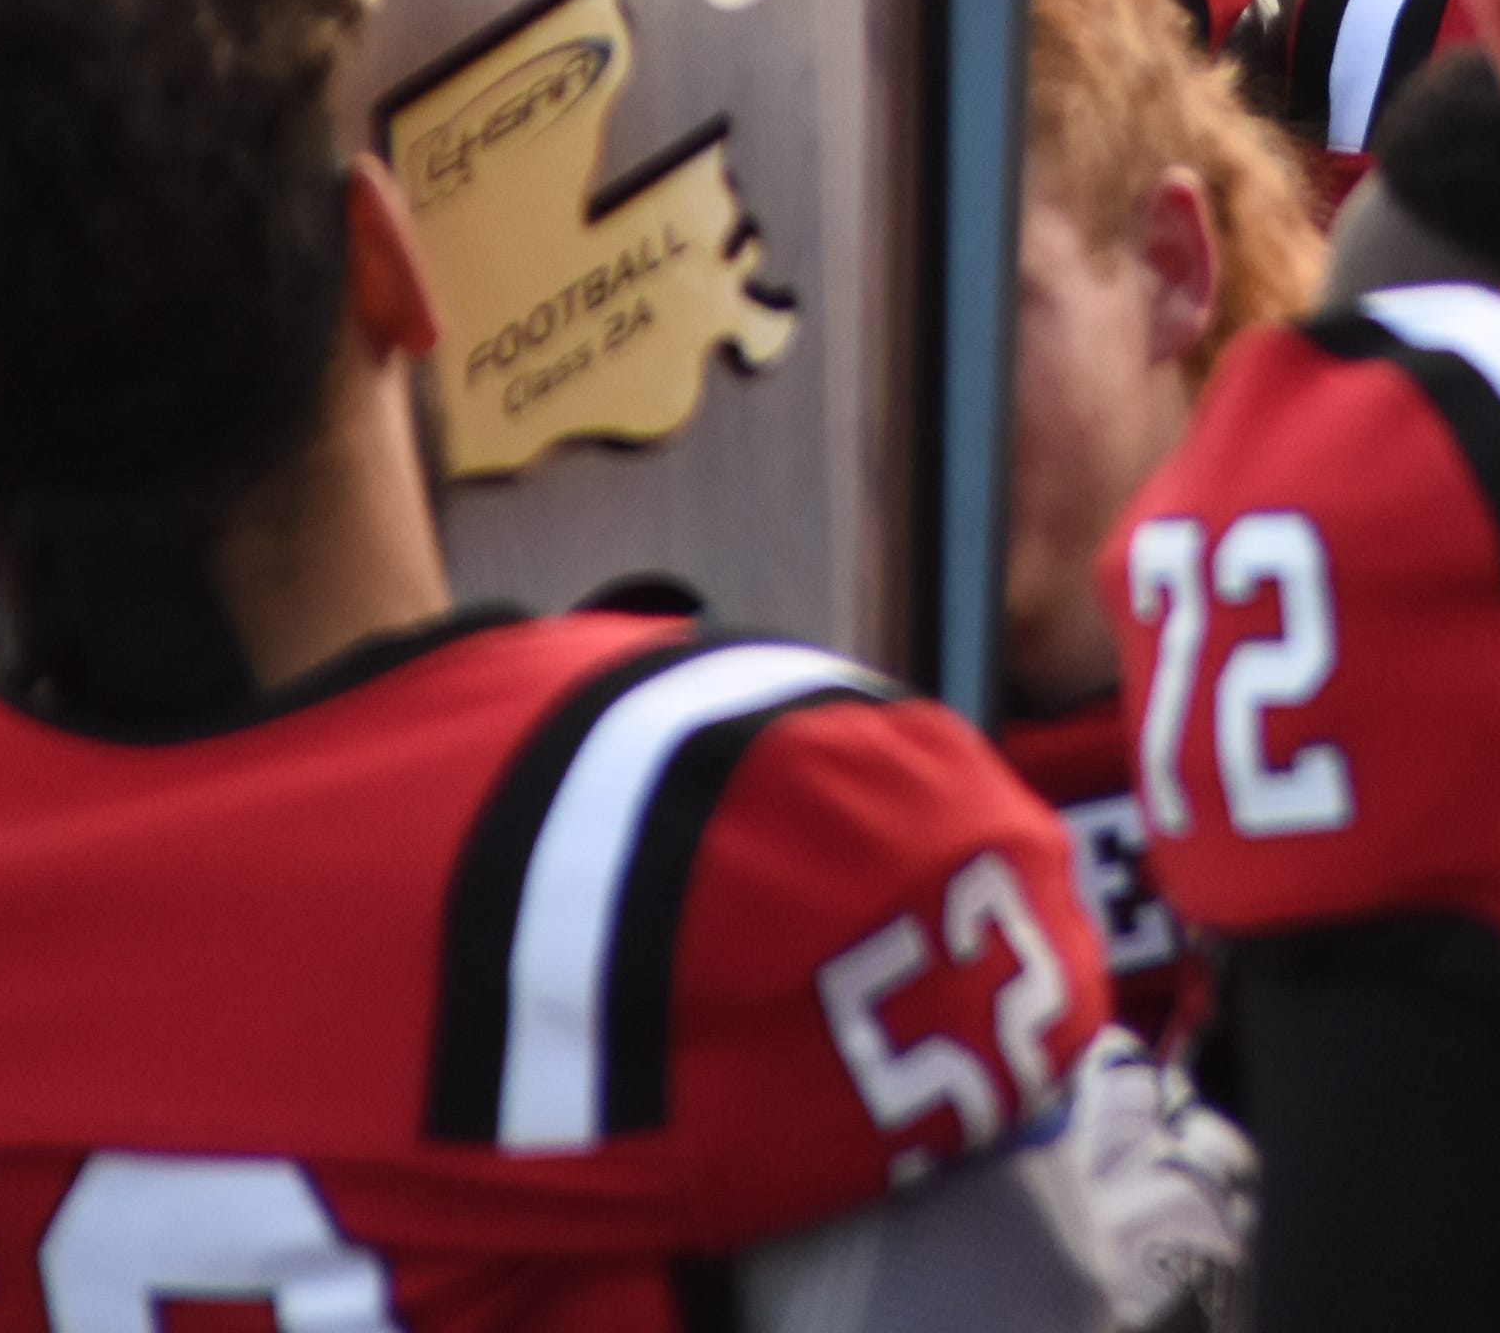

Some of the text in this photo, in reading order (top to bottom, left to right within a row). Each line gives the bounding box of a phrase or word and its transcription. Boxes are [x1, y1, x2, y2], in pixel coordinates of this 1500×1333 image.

[465, 221, 690, 393] FOOTBALL
[1126, 511, 1358, 841] 72
[814, 847, 1070, 1191] 52
